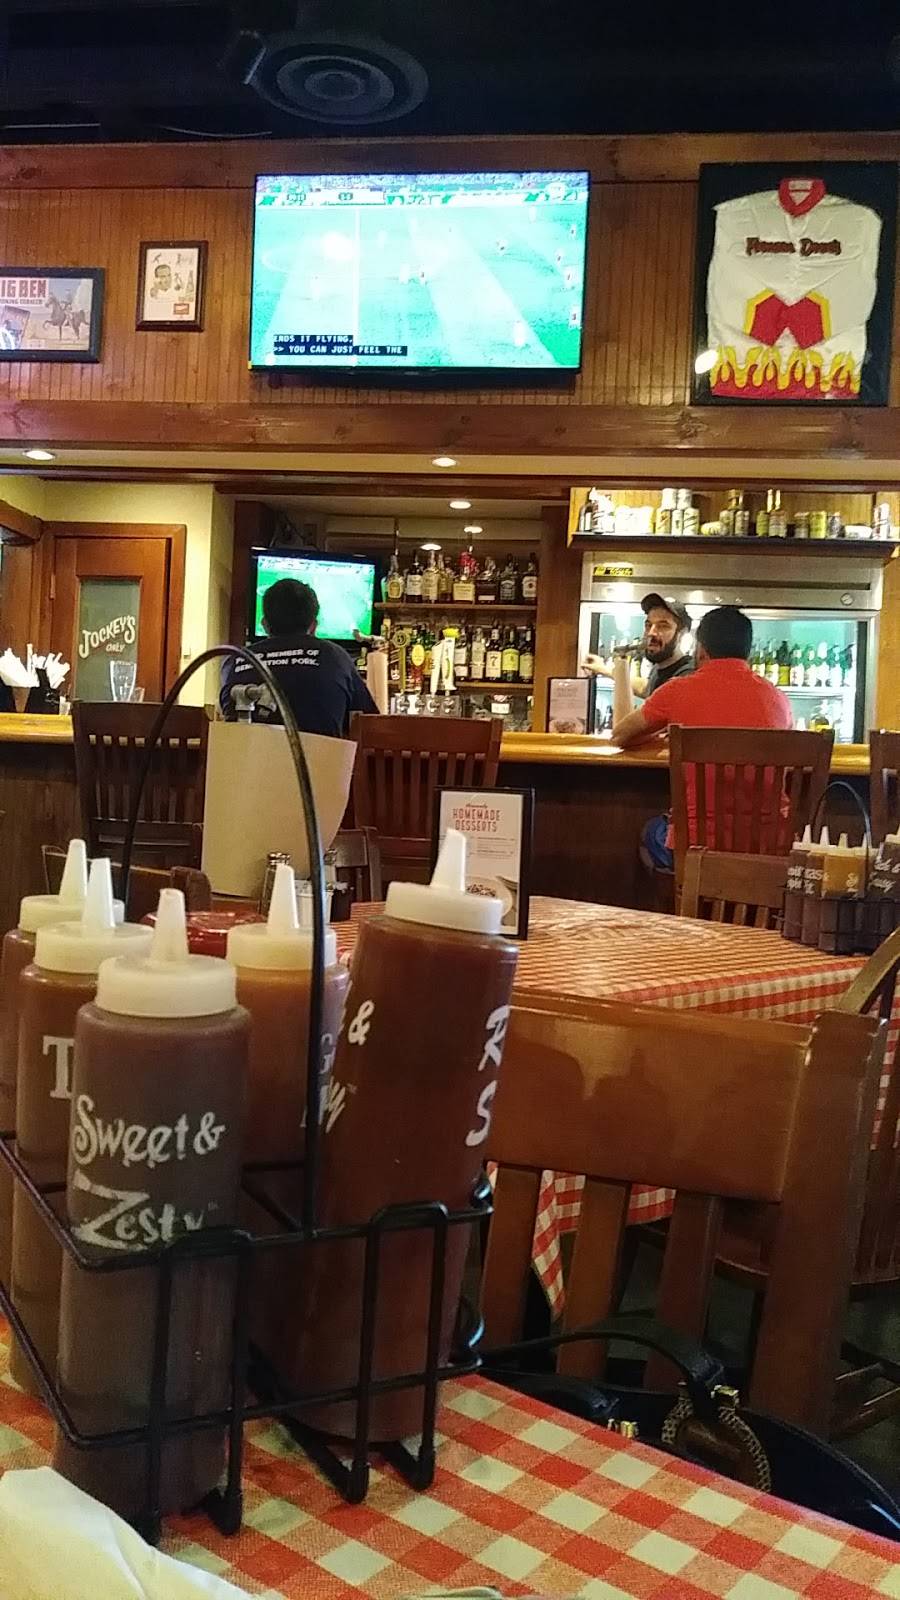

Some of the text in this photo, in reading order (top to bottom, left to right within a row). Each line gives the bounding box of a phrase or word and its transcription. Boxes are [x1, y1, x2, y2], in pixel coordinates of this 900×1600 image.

[19, 279, 47, 298] BEN
[300, 335, 311, 343] IT
[289, 345, 306, 354] YOU
[310, 345, 327, 354] CAN
[331, 345, 353, 354] JUST
[358, 346, 381, 354] FEEL
[386, 346, 403, 354] THE
[79, 615, 136, 659] JOCKEY'S
[266, 648, 304, 659] MEMBER
[306, 648, 320, 657] OF
[452, 808, 501, 821] HOMEMADE
[454, 819, 498, 832] DESSERTS
[73, 1094, 226, 1169] Sweet &
